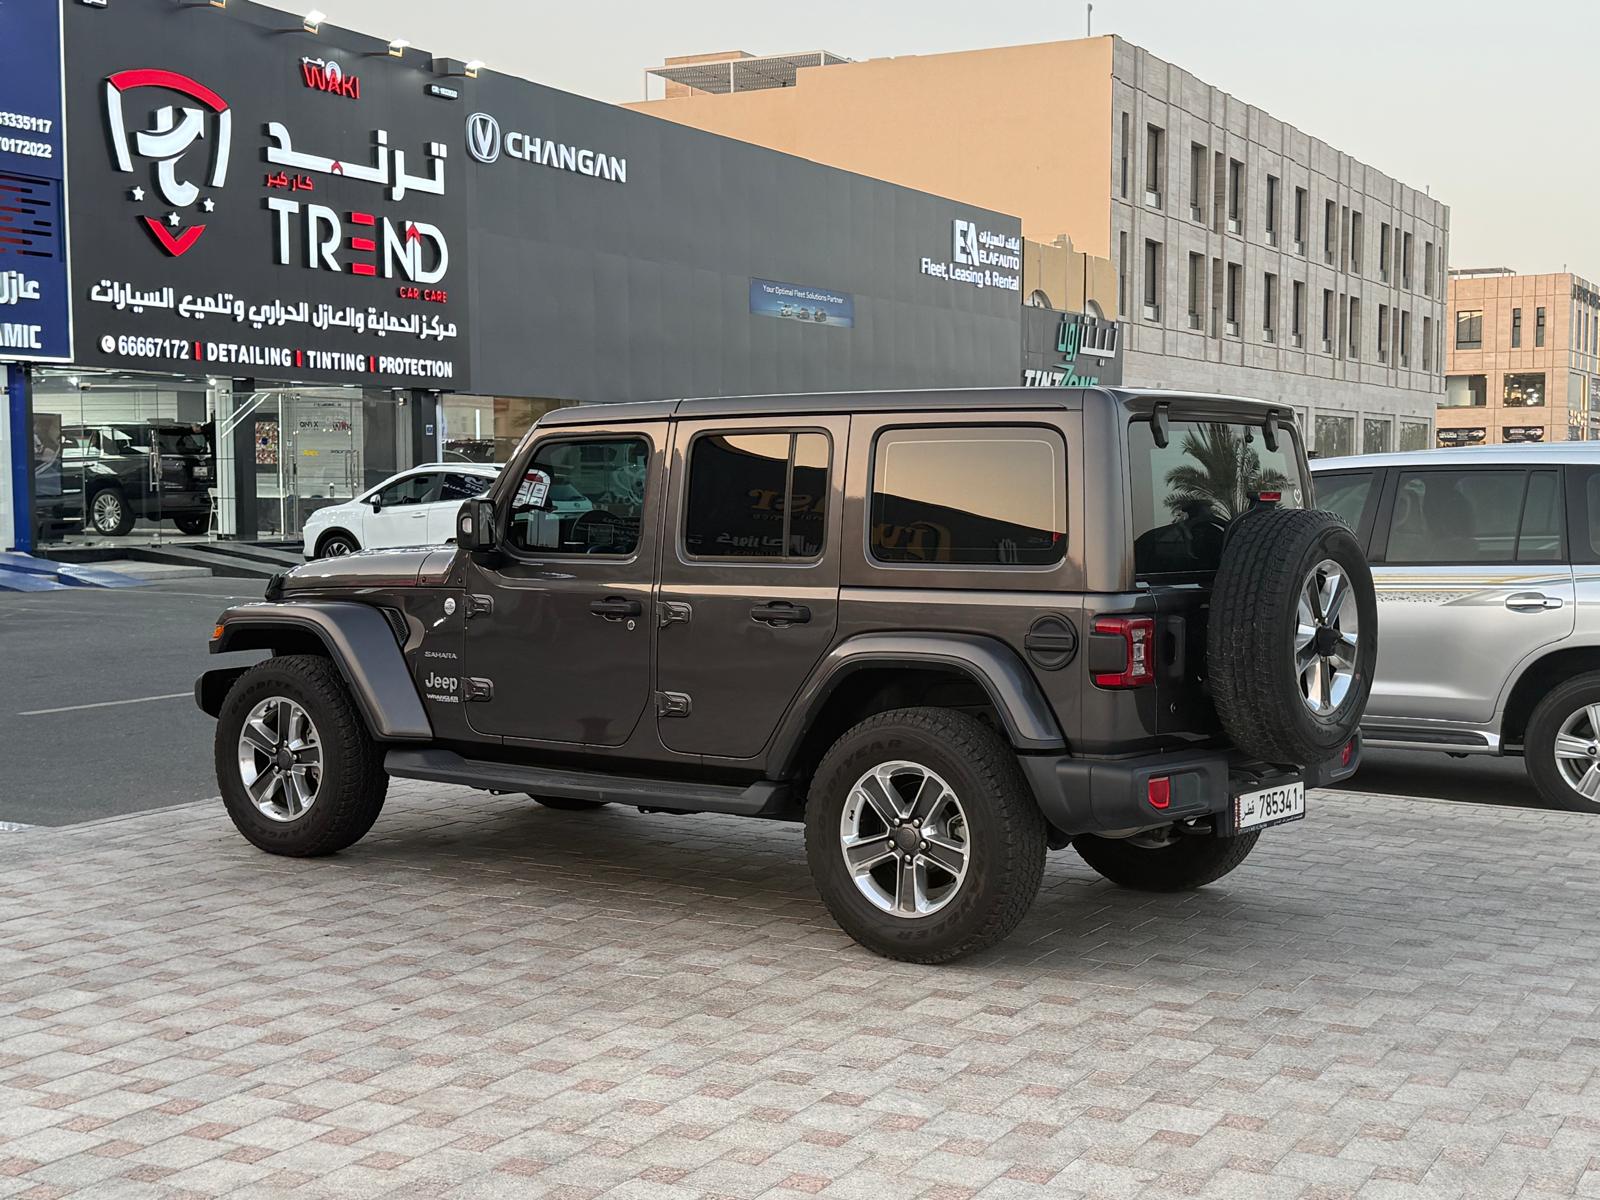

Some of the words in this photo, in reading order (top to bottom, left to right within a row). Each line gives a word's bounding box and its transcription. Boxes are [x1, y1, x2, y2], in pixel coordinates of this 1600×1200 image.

[303, 63, 360, 99] WAKI
[0, 112, 52, 134] 3335117
[0, 136, 52, 158] 0172022
[267, 122, 447, 201] ترند
[504, 132, 627, 183] CHANGAN
[268, 197, 448, 284] TREND
[949, 263, 983, 288] Leasing
[985, 270, 992, 286] &
[992, 271, 1020, 291] Rental
[91, 279, 174, 313] السيارات
[400, 286, 419, 299] CAR
[424, 289, 447, 303] CARE
[249, 299, 308, 329] الحراري
[313, 303, 365, 333] والعازل
[367, 307, 419, 337] الحماية
[421, 314, 457, 341] مركز
[118, 335, 189, 360] 66667172
[207, 342, 291, 367] DETAILING
[307, 350, 365, 372] TINTING
[379, 356, 453, 378] PROTECTION
[425, 671, 458, 693] Jeep
[1241, 800, 1255, 821] قطر
[1259, 787, 1298, 819] 785341
